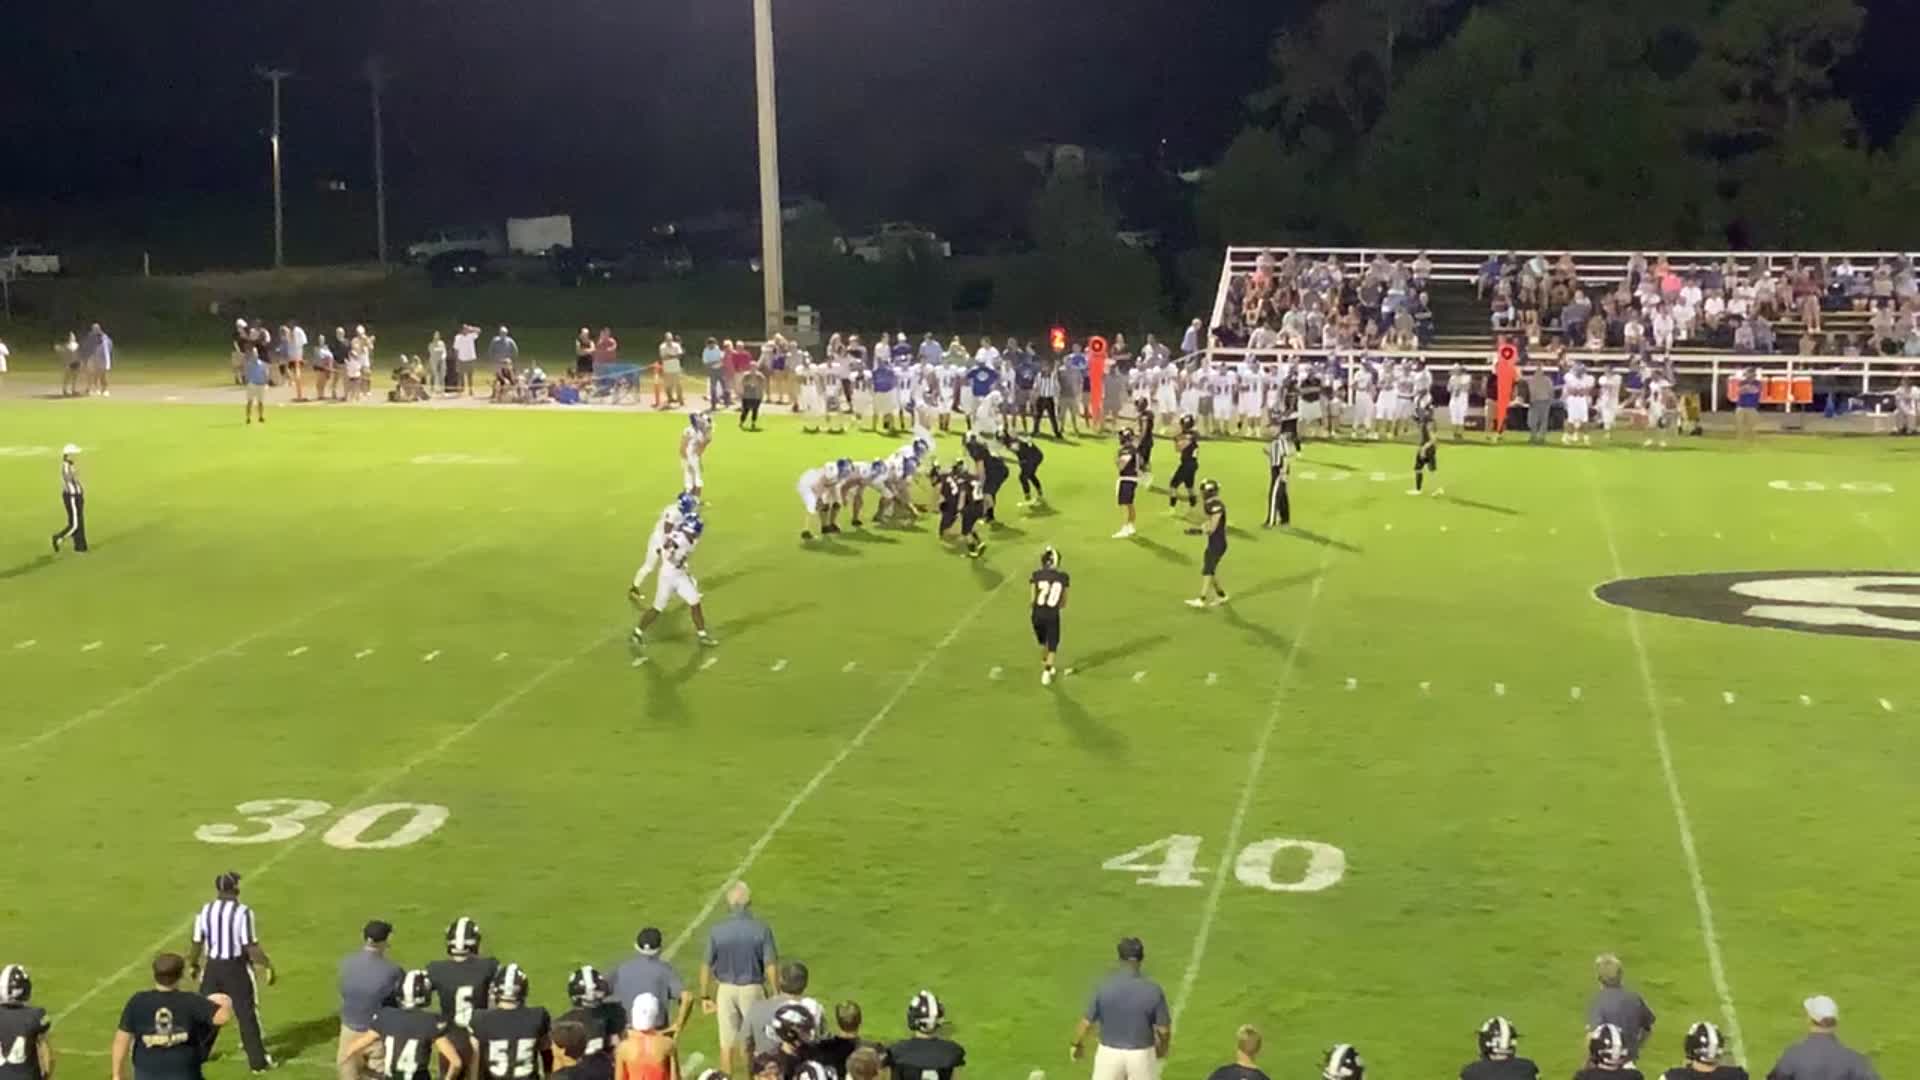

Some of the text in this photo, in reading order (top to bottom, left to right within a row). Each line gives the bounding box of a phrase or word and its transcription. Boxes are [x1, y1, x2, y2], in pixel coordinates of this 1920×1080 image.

[194, 799, 450, 849] 30
[1102, 834, 1346, 891] 40
[384, 1036, 419, 1080] 14
[489, 1038, 537, 1078] 55
